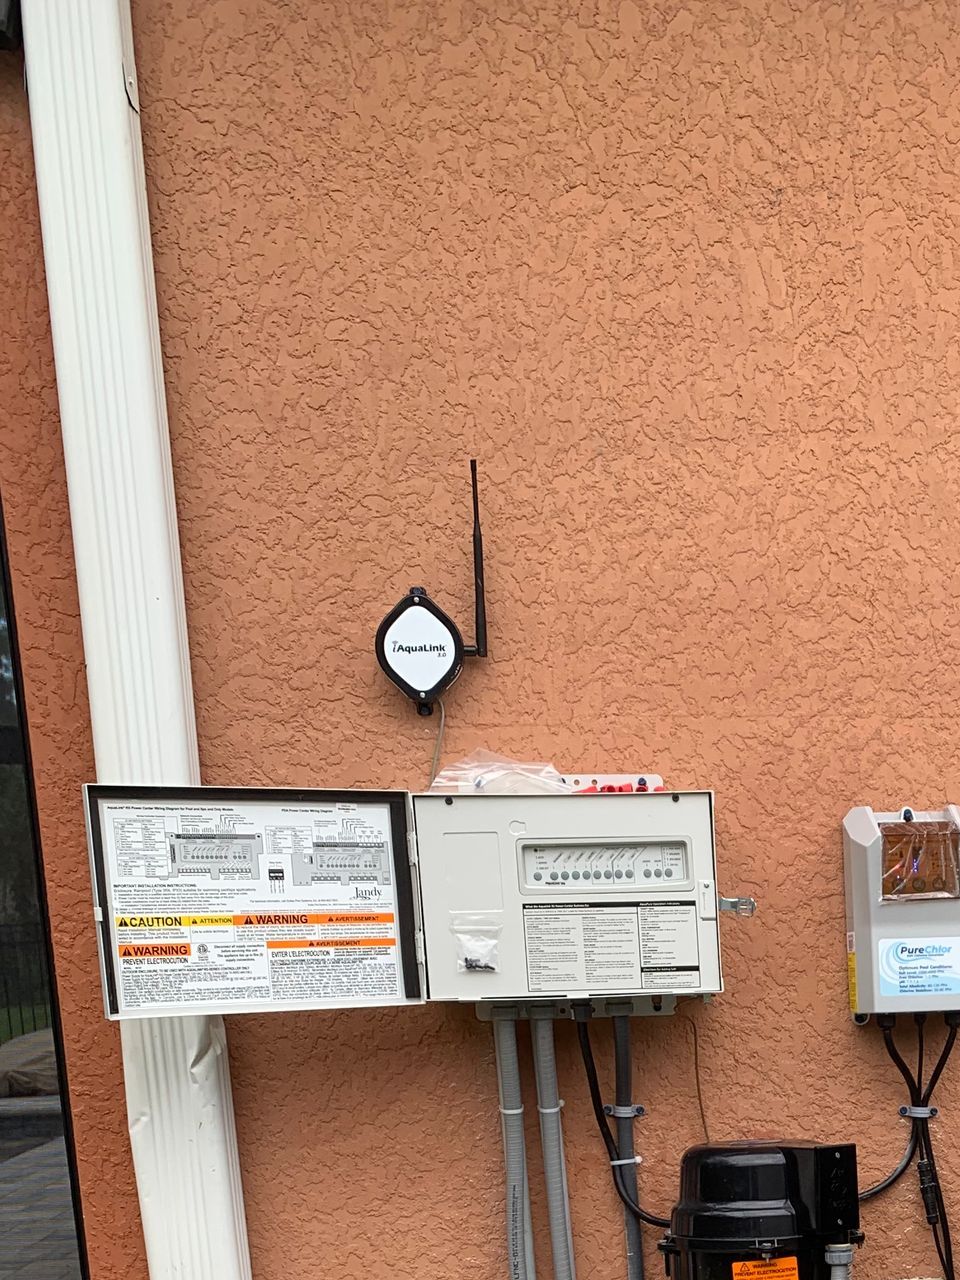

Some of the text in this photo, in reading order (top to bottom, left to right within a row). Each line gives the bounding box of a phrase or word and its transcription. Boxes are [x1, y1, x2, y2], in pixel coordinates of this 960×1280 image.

[353, 886, 382, 900] Jandy
[130, 917, 182, 927] CAUTION
[256, 915, 308, 924] WARNING
[133, 946, 187, 956] WARNING
[900, 945, 952, 954] PureChlor
[756, 1267, 796, 1275] ELECTROCUTION
